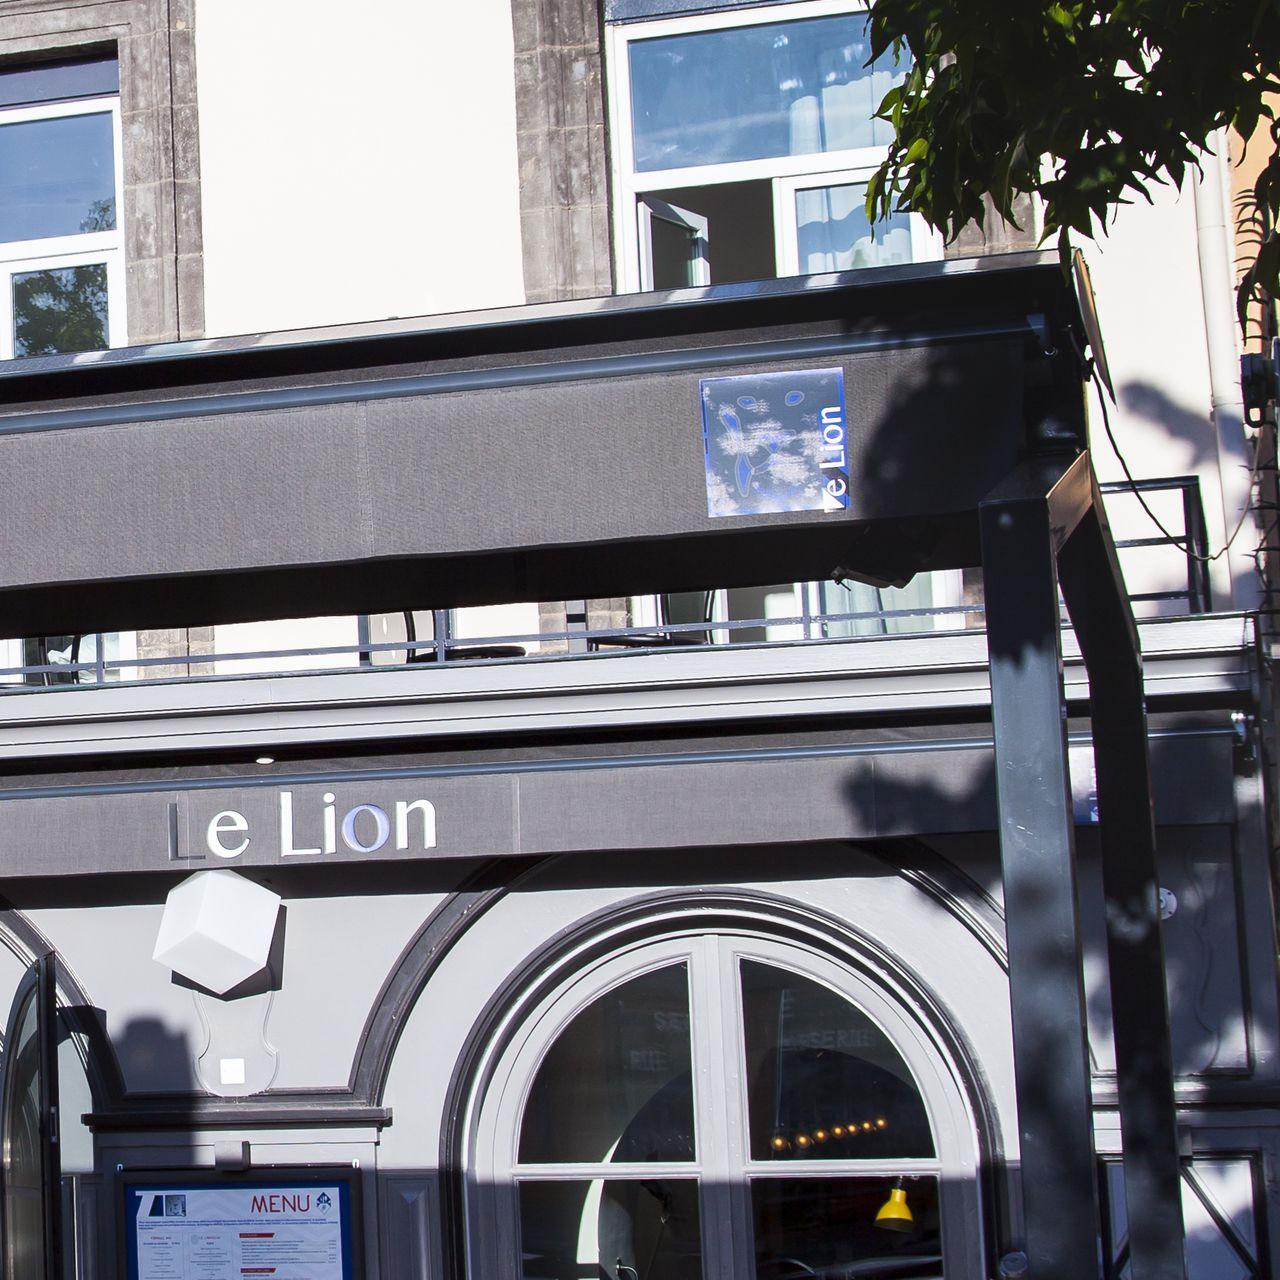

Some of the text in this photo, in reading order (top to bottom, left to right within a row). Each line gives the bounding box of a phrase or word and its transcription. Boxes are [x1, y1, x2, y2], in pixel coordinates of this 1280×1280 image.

[818, 405, 846, 470] Lion
[280, 791, 437, 857] Lion
[250, 1194, 311, 1214] MENU
